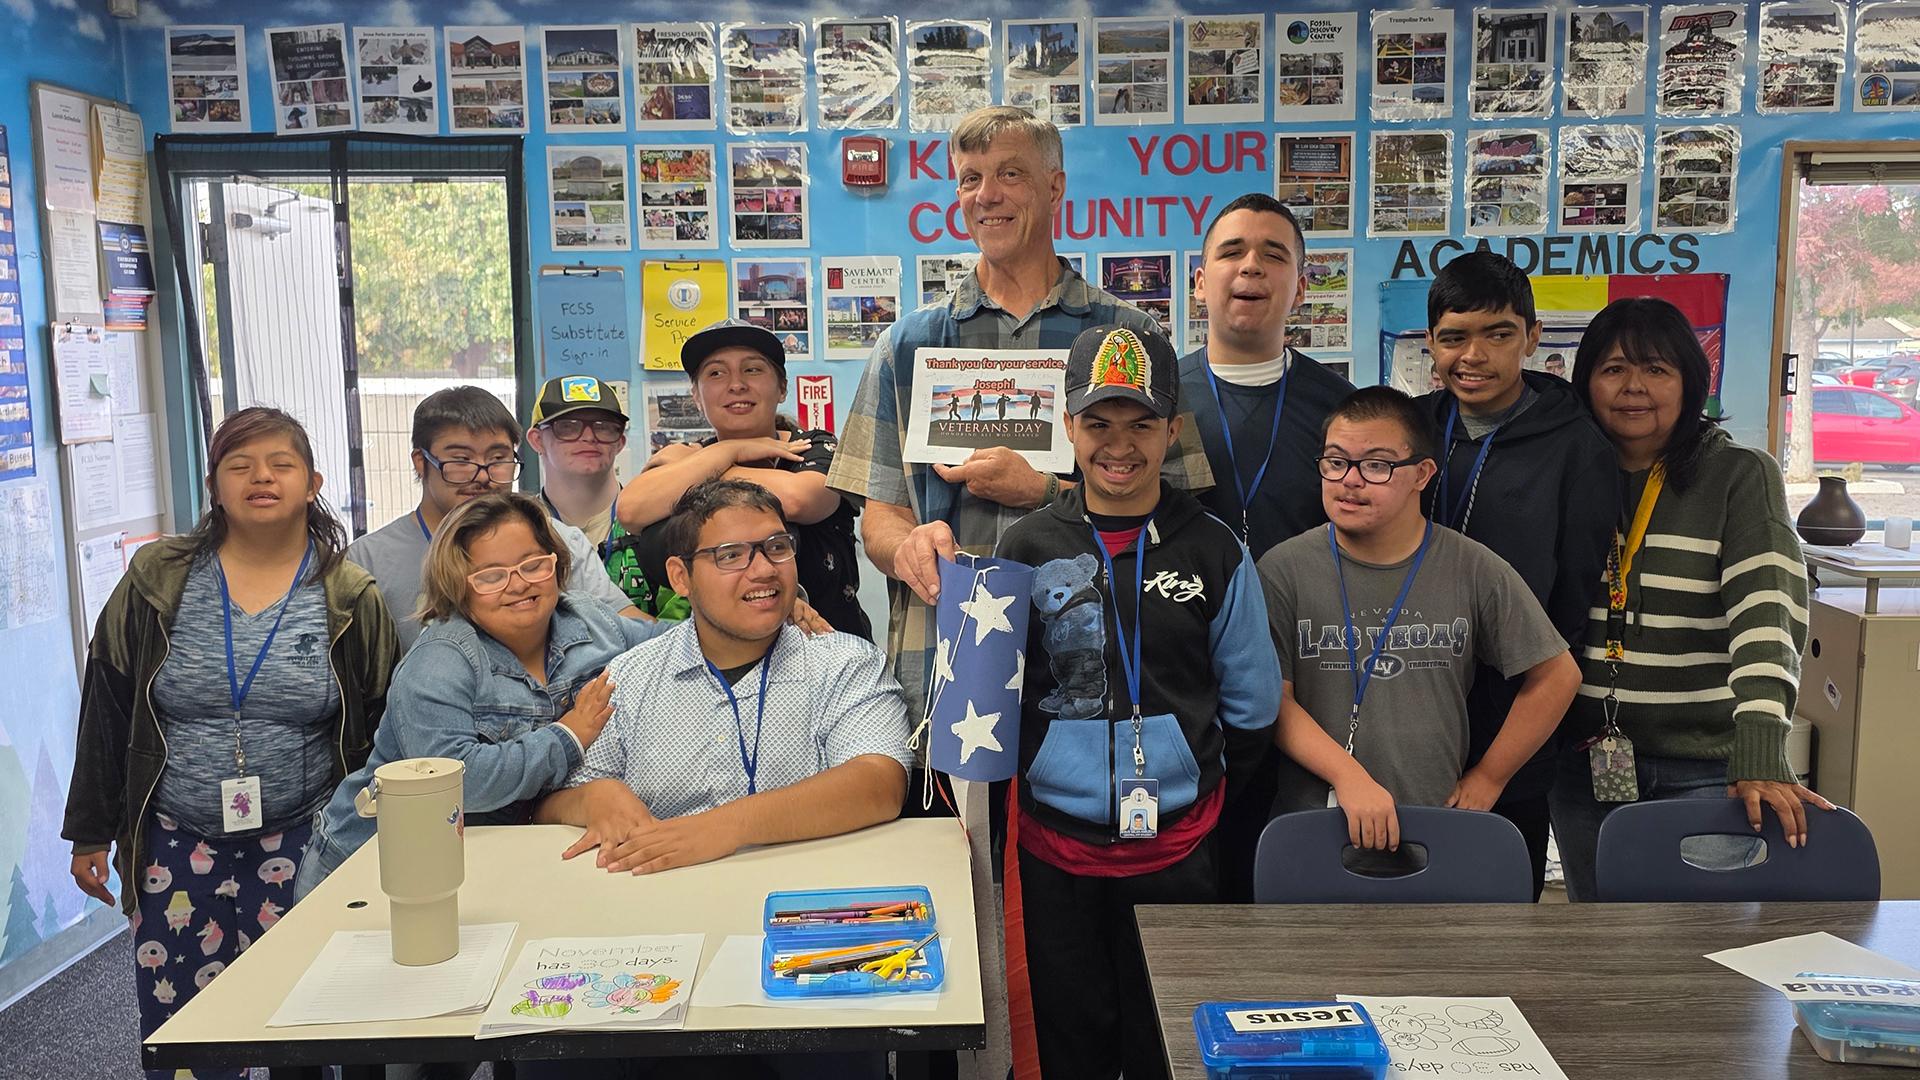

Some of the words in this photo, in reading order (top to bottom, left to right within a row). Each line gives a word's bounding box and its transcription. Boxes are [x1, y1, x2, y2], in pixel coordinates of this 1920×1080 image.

[1128, 131, 1267, 176] YOUR
[561, 302, 595, 316] FCSS
[654, 313, 697, 328] Service
[551, 324, 626, 341] Substitute
[560, 350, 609, 365] Sign-in
[926, 358, 958, 369] Thank
[960, 361, 980, 371] you
[982, 359, 998, 369] for
[1000, 361, 1025, 371] your
[1025, 358, 1067, 371] service,
[973, 378, 1016, 391] Joseph!
[803, 385, 827, 400] FIRE
[939, 423, 1009, 433] VETERANS
[1014, 423, 1043, 433] DAY
[1142, 570, 1207, 603] King
[1298, 618, 1362, 659] LAS
[1366, 617, 1469, 657] VEGAS
[539, 944, 683, 958] November
[537, 961, 571, 971] has
[577, 958, 620, 970] 30
[625, 956, 679, 968] days.
[1781, 981, 1920, 998] gelina
[1246, 1008, 1353, 1026] Jesus
[1451, 1061, 1494, 1074] 30
[1498, 1062, 1541, 1075] has
